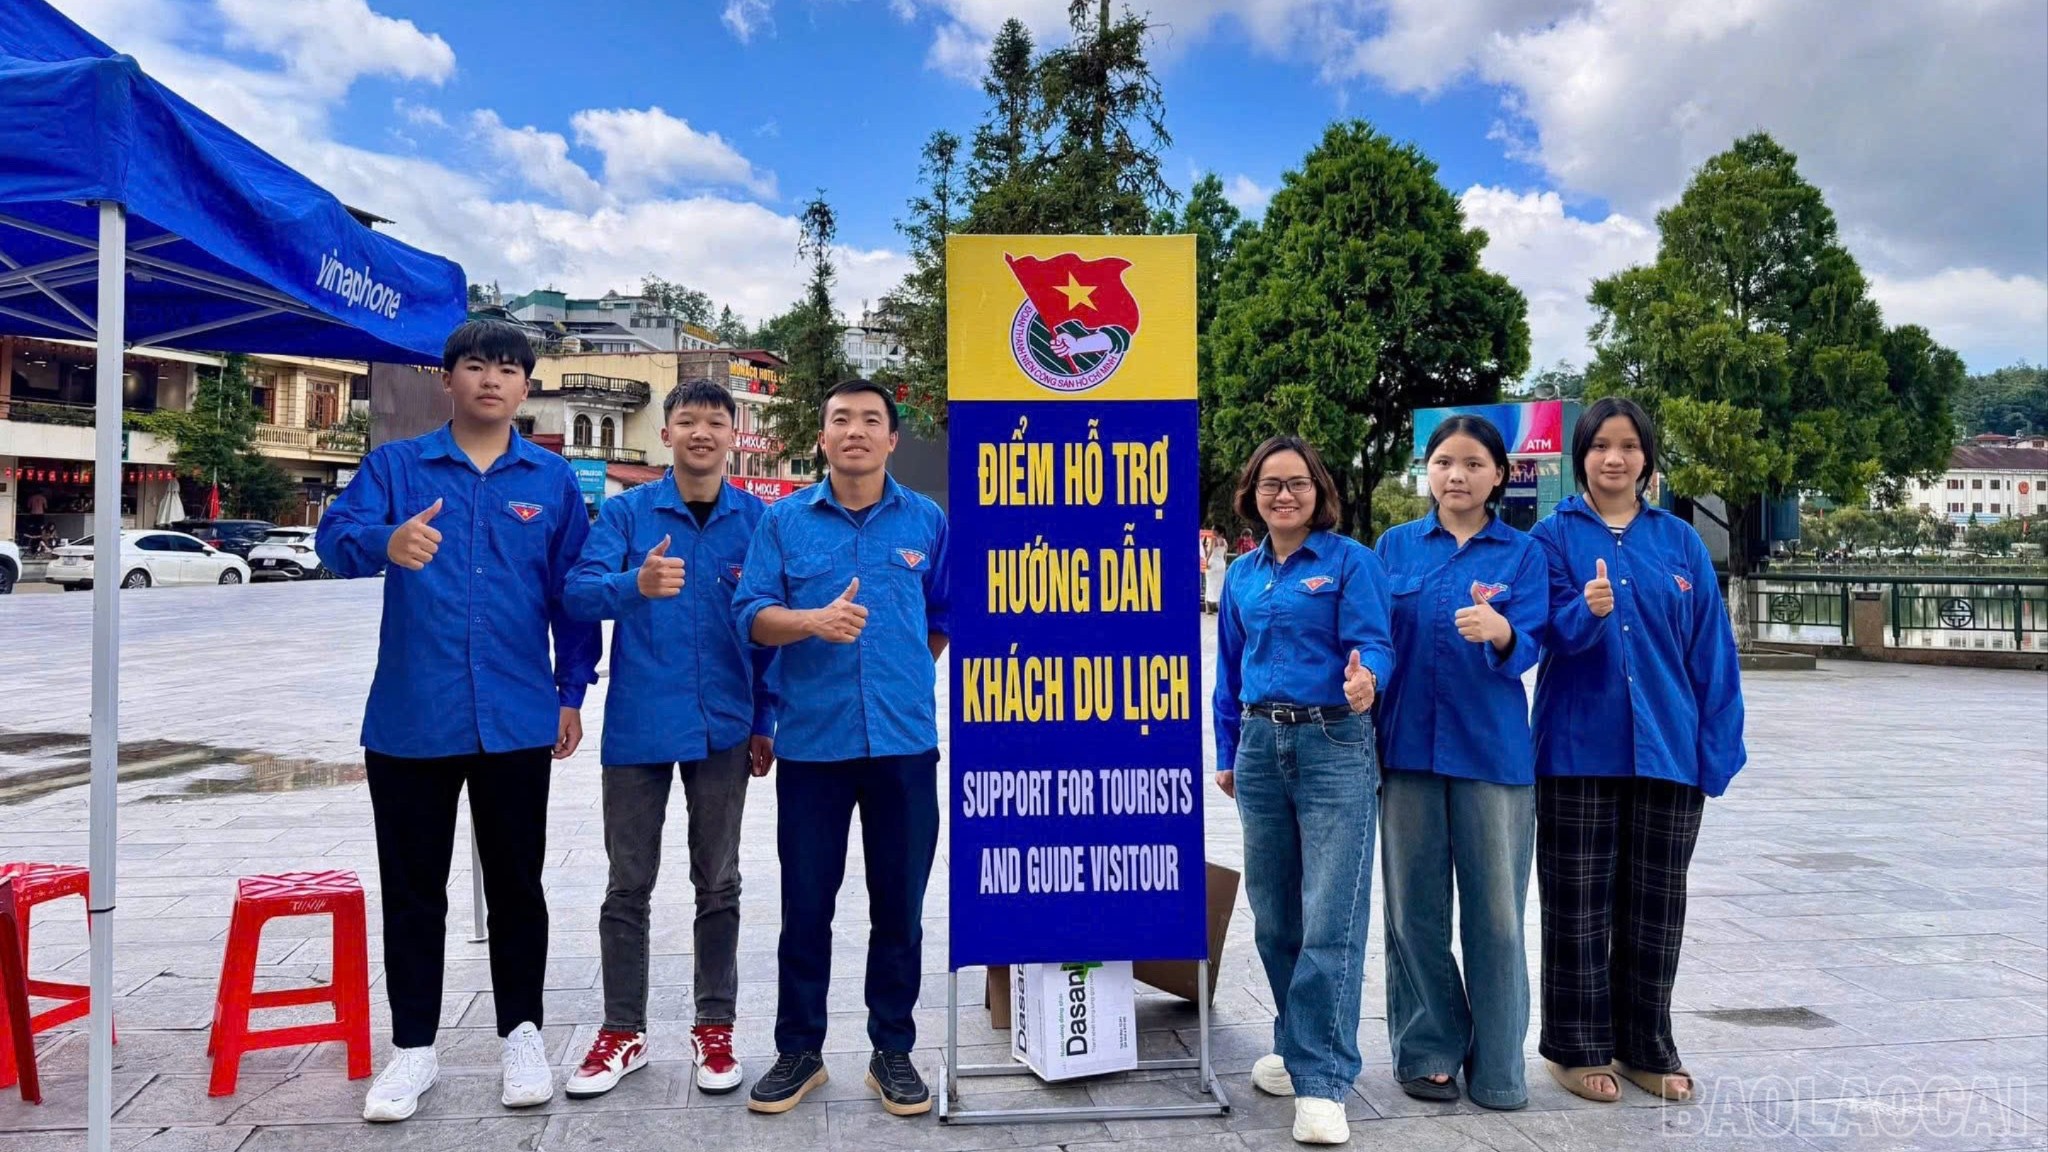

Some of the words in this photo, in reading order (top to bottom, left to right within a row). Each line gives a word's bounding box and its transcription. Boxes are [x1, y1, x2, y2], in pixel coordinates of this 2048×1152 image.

[316, 248, 401, 319] vinaphone
[1015, 328, 1025, 355] THANH
[759, 367, 777, 382] HOTEL
[741, 435, 766, 449] MIXUE
[978, 415, 1054, 505] ĐIỂM
[1064, 418, 1103, 505] HỖ
[1112, 435, 1169, 519] TRỢ
[1526, 438, 1551, 450] ATM
[755, 483, 780, 495] MIXUE
[988, 535, 1090, 613] HƯỚNG
[1100, 523, 1161, 612] DẪN
[963, 643, 1064, 722] KHÁCH
[1073, 656, 1113, 721] DU
[1123, 655, 1190, 735] LỊCH
[963, 770, 1052, 818] SUPPORT
[1058, 769, 1094, 816] FOR
[1100, 768, 1193, 815] TOURISTS
[980, 848, 1020, 894] AND
[1027, 846, 1085, 894] GUIDE
[1090, 844, 1179, 892] VISITOUR
[1018, 963, 1027, 1054] Dasan
